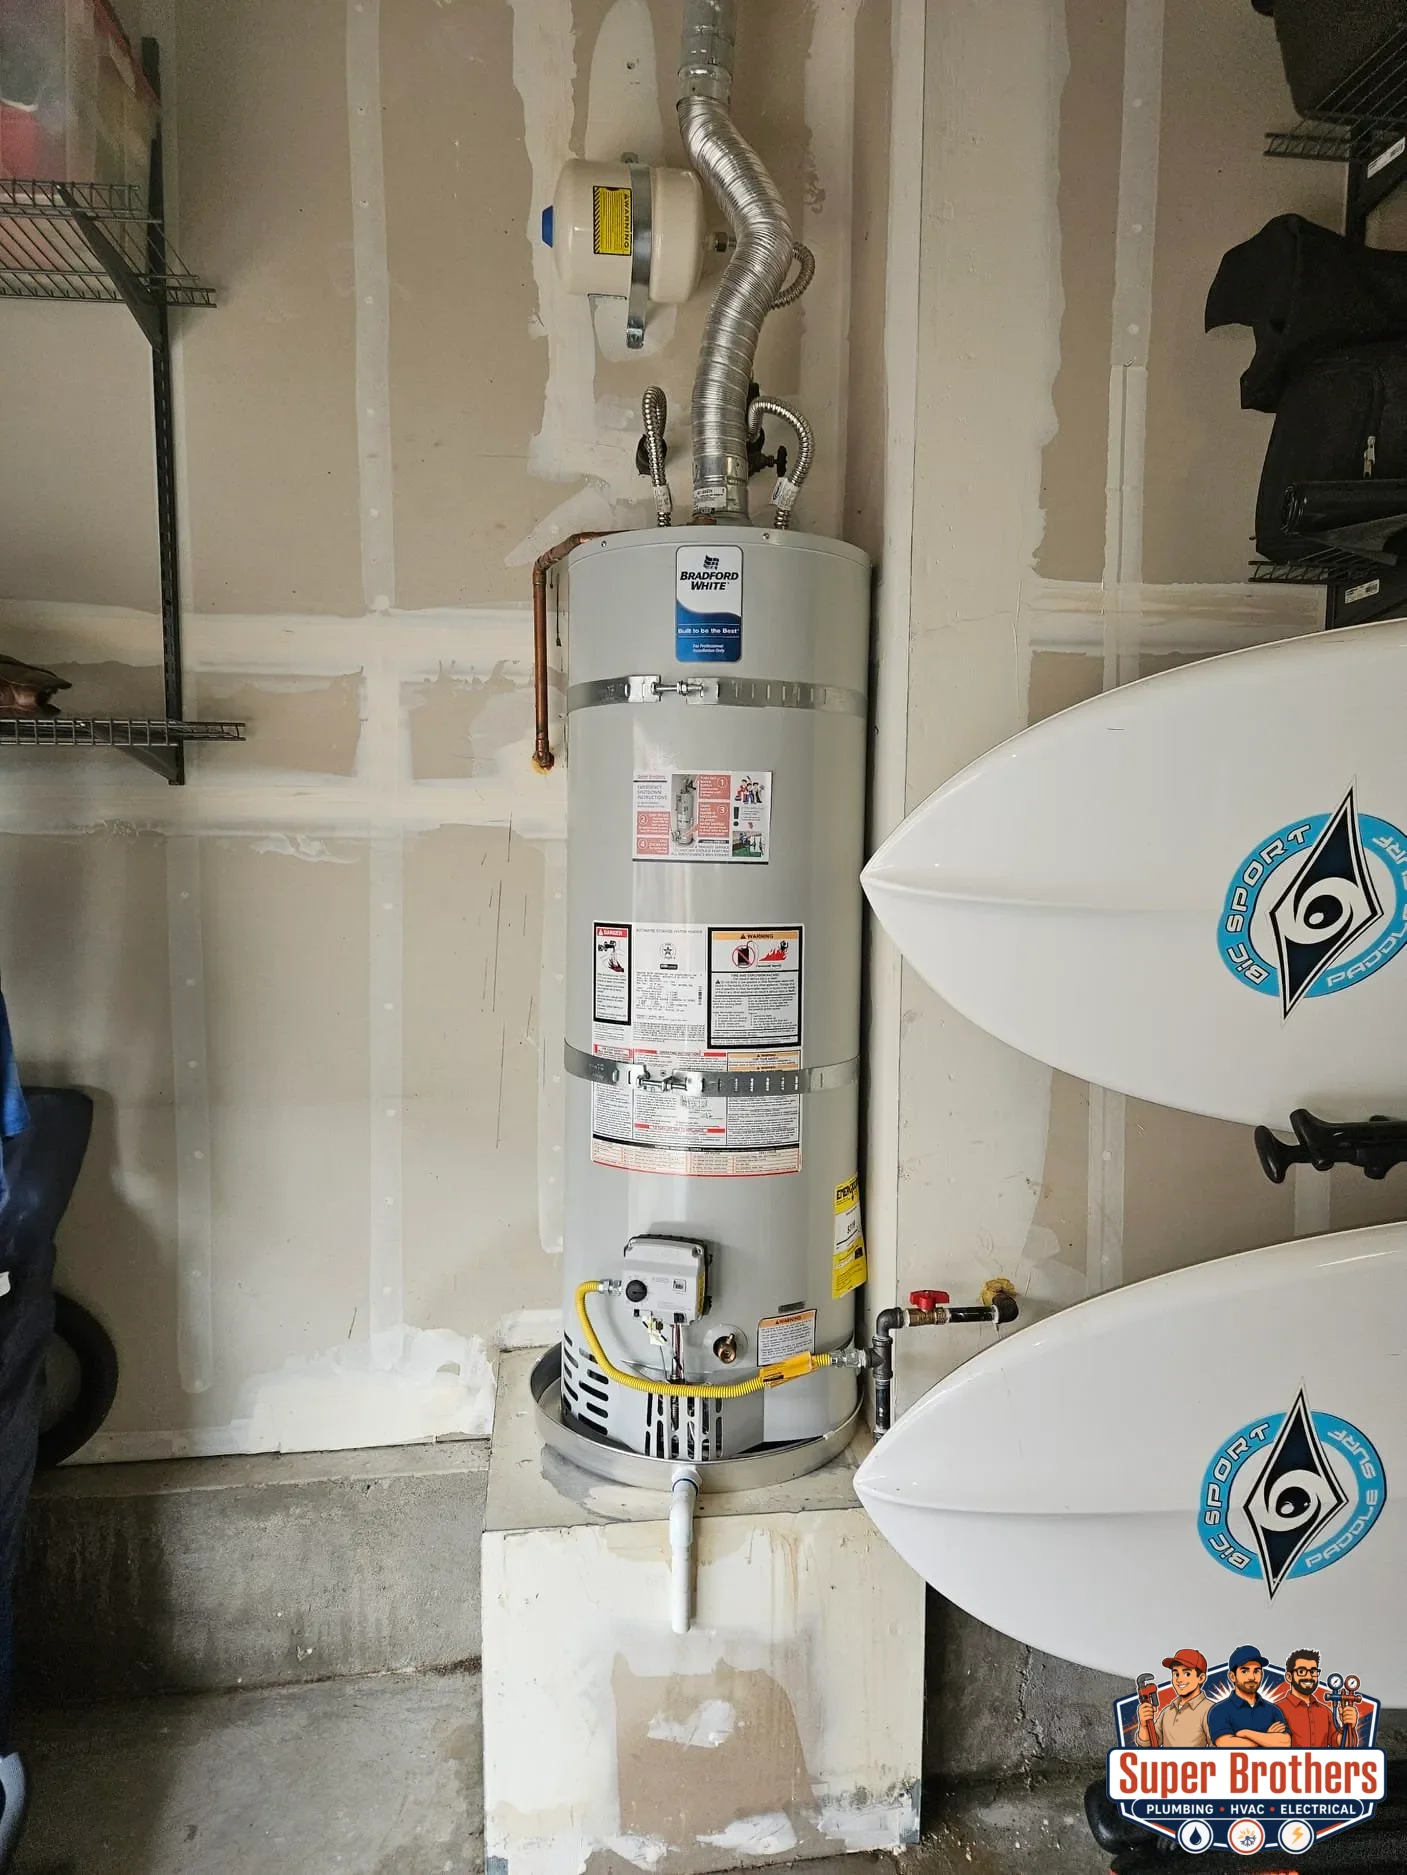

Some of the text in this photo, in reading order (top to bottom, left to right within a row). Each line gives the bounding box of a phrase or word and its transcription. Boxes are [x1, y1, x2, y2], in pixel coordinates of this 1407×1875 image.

[680, 571, 739, 581] BRADFORD
[691, 581, 727, 591] WHITE
[1225, 824, 1311, 932] SPORT
[1327, 904, 1407, 987] PADDL
[779, 1315, 802, 1323] WARNING
[1204, 1422, 1270, 1525] SPORT
[1305, 1430, 1378, 1568] PADDLE SURF
